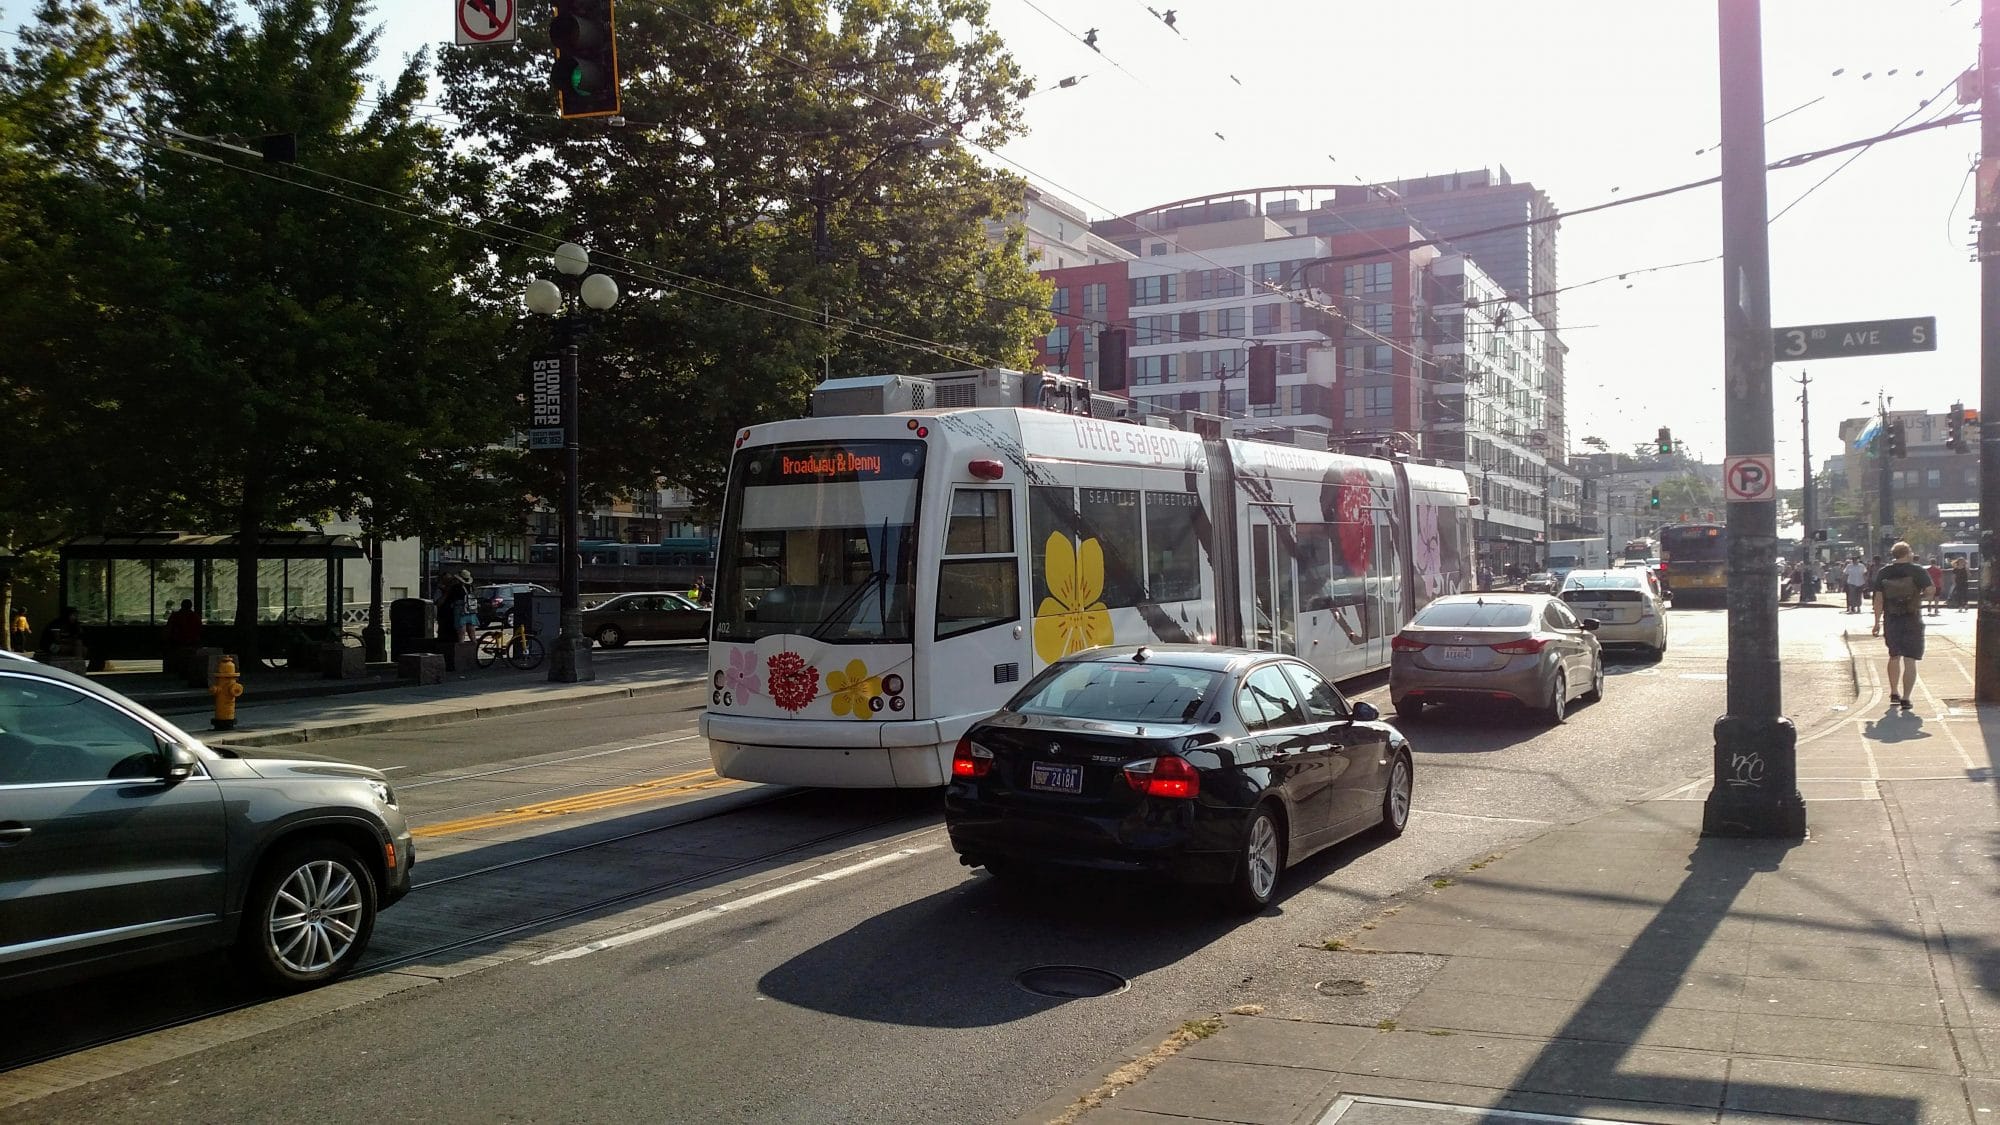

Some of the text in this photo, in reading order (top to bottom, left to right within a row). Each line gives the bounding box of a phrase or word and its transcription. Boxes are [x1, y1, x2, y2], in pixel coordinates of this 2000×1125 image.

[1843, 331, 1880, 347] AVE
[1912, 326, 1926, 344] S
[533, 360, 546, 425] SQUARE
[546, 359, 560, 425] PIONEER
[1073, 419, 1181, 464] little saigon
[783, 452, 880, 476] Broadway & Denny
[1263, 448, 1319, 472] chinatown
[1089, 490, 1199, 507] SEATTLE STREETCAR
[717, 622, 730, 634] 402
